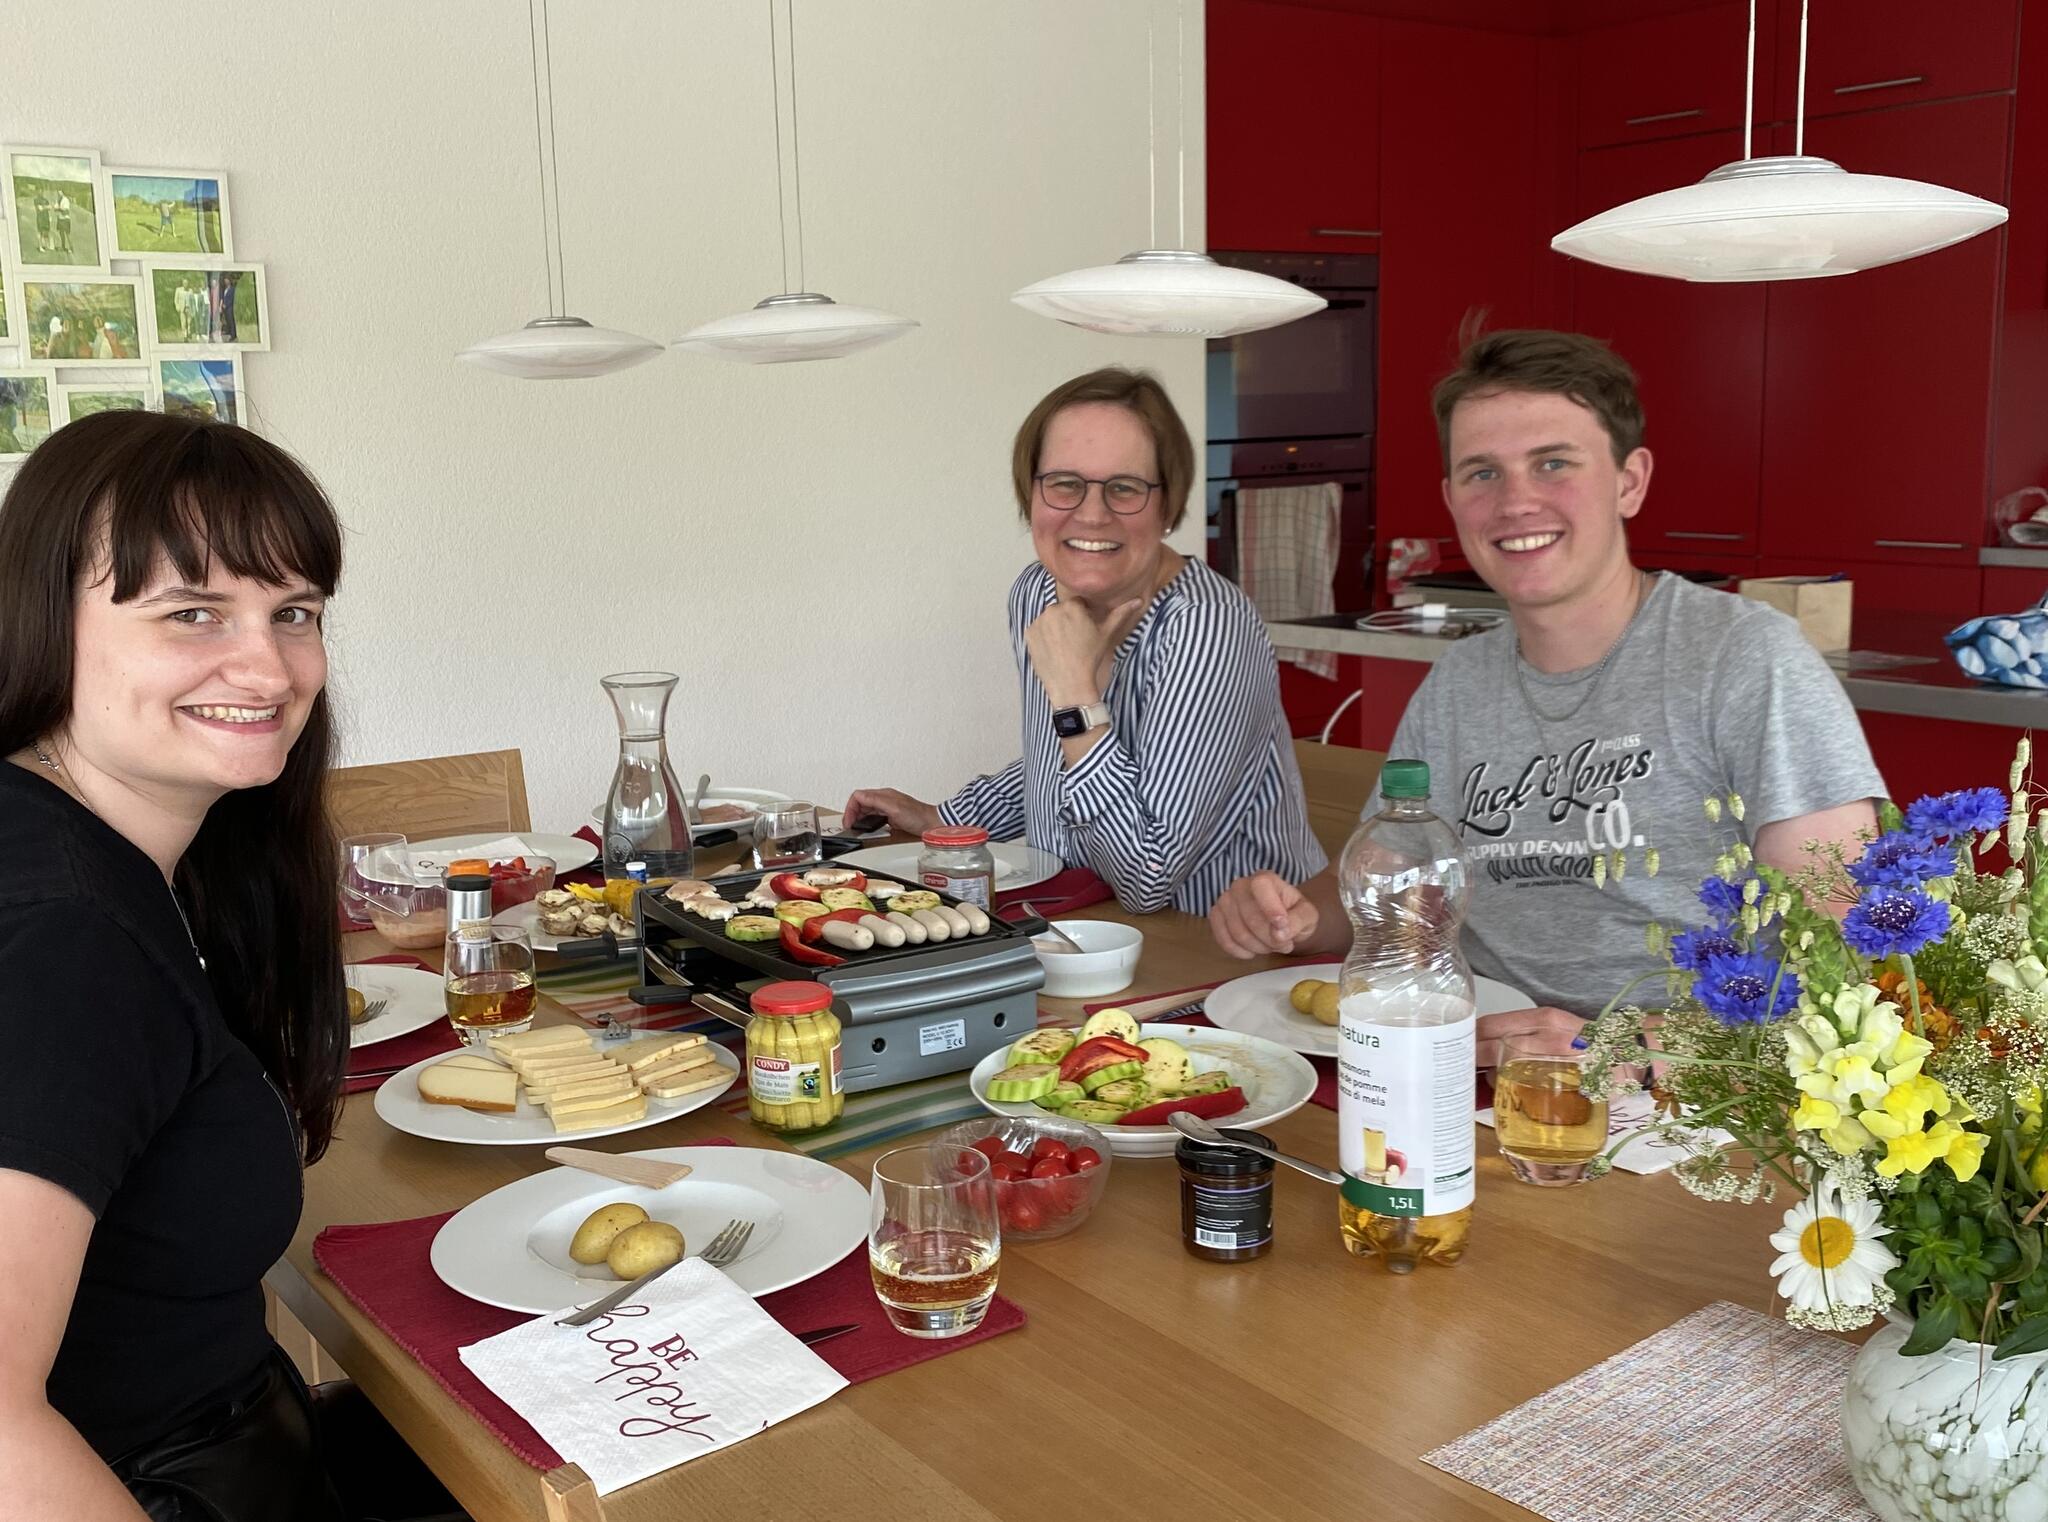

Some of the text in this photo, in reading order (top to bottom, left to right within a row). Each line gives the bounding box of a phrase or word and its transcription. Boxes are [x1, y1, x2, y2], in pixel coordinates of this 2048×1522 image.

[1458, 738, 1655, 838] Jack & Jones
[1586, 800, 1645, 850] CO.
[1523, 840, 1589, 855] DENIM
[1487, 854, 1609, 884] QUALITY GOOD
[756, 1059, 787, 1070] CONDY
[1353, 1079, 1387, 1094] pomme
[1362, 1095, 1386, 1107] mela
[1388, 1196, 1417, 1211] 1,5L
[647, 1332, 699, 1371] BE
[576, 1304, 716, 1442] happy
